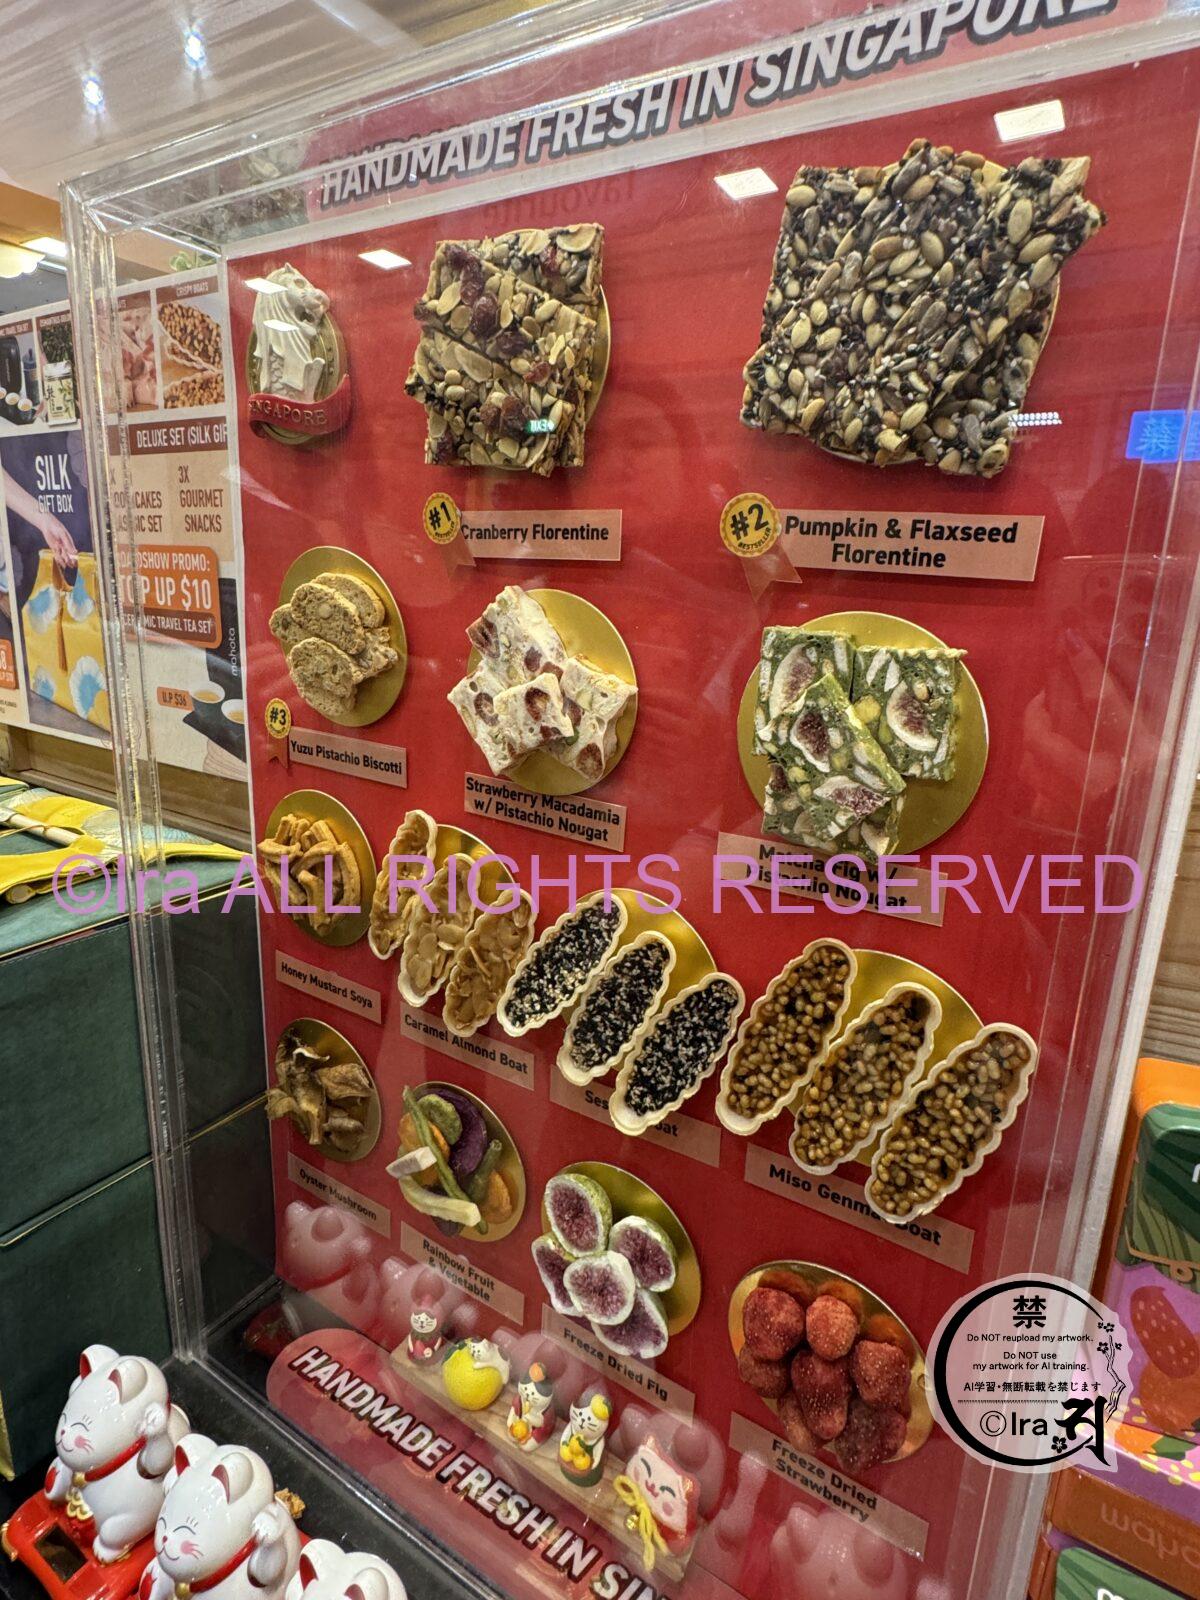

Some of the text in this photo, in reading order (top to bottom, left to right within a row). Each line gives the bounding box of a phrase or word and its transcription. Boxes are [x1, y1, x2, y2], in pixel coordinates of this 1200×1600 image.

[319, 122, 518, 208] HANDMADE
[526, 79, 679, 163] FRESH
[682, 61, 745, 125] IN
[137, 430, 169, 448] DELUXE
[170, 427, 186, 447] SET
[187, 425, 212, 446] (SILK
[35, 454, 72, 491] SILK
[178, 465, 190, 483] 3X
[38, 494, 74, 514] GIFT BOX
[180, 489, 224, 509] GOURMET
[429, 501, 452, 530] #1
[147, 515, 163, 533] SET
[185, 515, 222, 533] SNACKS
[461, 522, 609, 543] Cranberry Florentine
[730, 503, 769, 541] #2
[738, 527, 772, 550] BESTSELLER
[784, 515, 1018, 544] Pumpkin & Flaxseed
[172, 553, 211, 572] PROMO:
[831, 543, 946, 568] Florentine
[154, 576, 176, 607] UP
[181, 574, 212, 612] $10
[157, 616, 183, 631] TRAVEL
[183, 618, 197, 632] TEA
[198, 620, 212, 635] SET
[269, 706, 287, 726] #3
[290, 739, 403, 775] Yuzu Pistachio Biscotti
[466, 776, 621, 826] Strawberry Macadamia
[474, 797, 609, 843] w/ Pistachio Nougat
[281, 961, 373, 1009] Honey Mustard Soya
[404, 1013, 528, 1074] Caramel Almond Boat
[299, 1168, 377, 1221] Oyster Mushroom
[769, 1163, 812, 1193] Miso
[423, 1239, 496, 1292] Rainbow Fruit
[428, 1256, 491, 1302] & Vegetable
[563, 1327, 669, 1403] Freeze Dried Fig
[288, 1345, 456, 1471] HANDMADE
[436, 1451, 559, 1551] FRESH
[542, 1526, 602, 1584] IN
[771, 1438, 878, 1511] Freeze Dried
[775, 1458, 870, 1523] Strawberry
